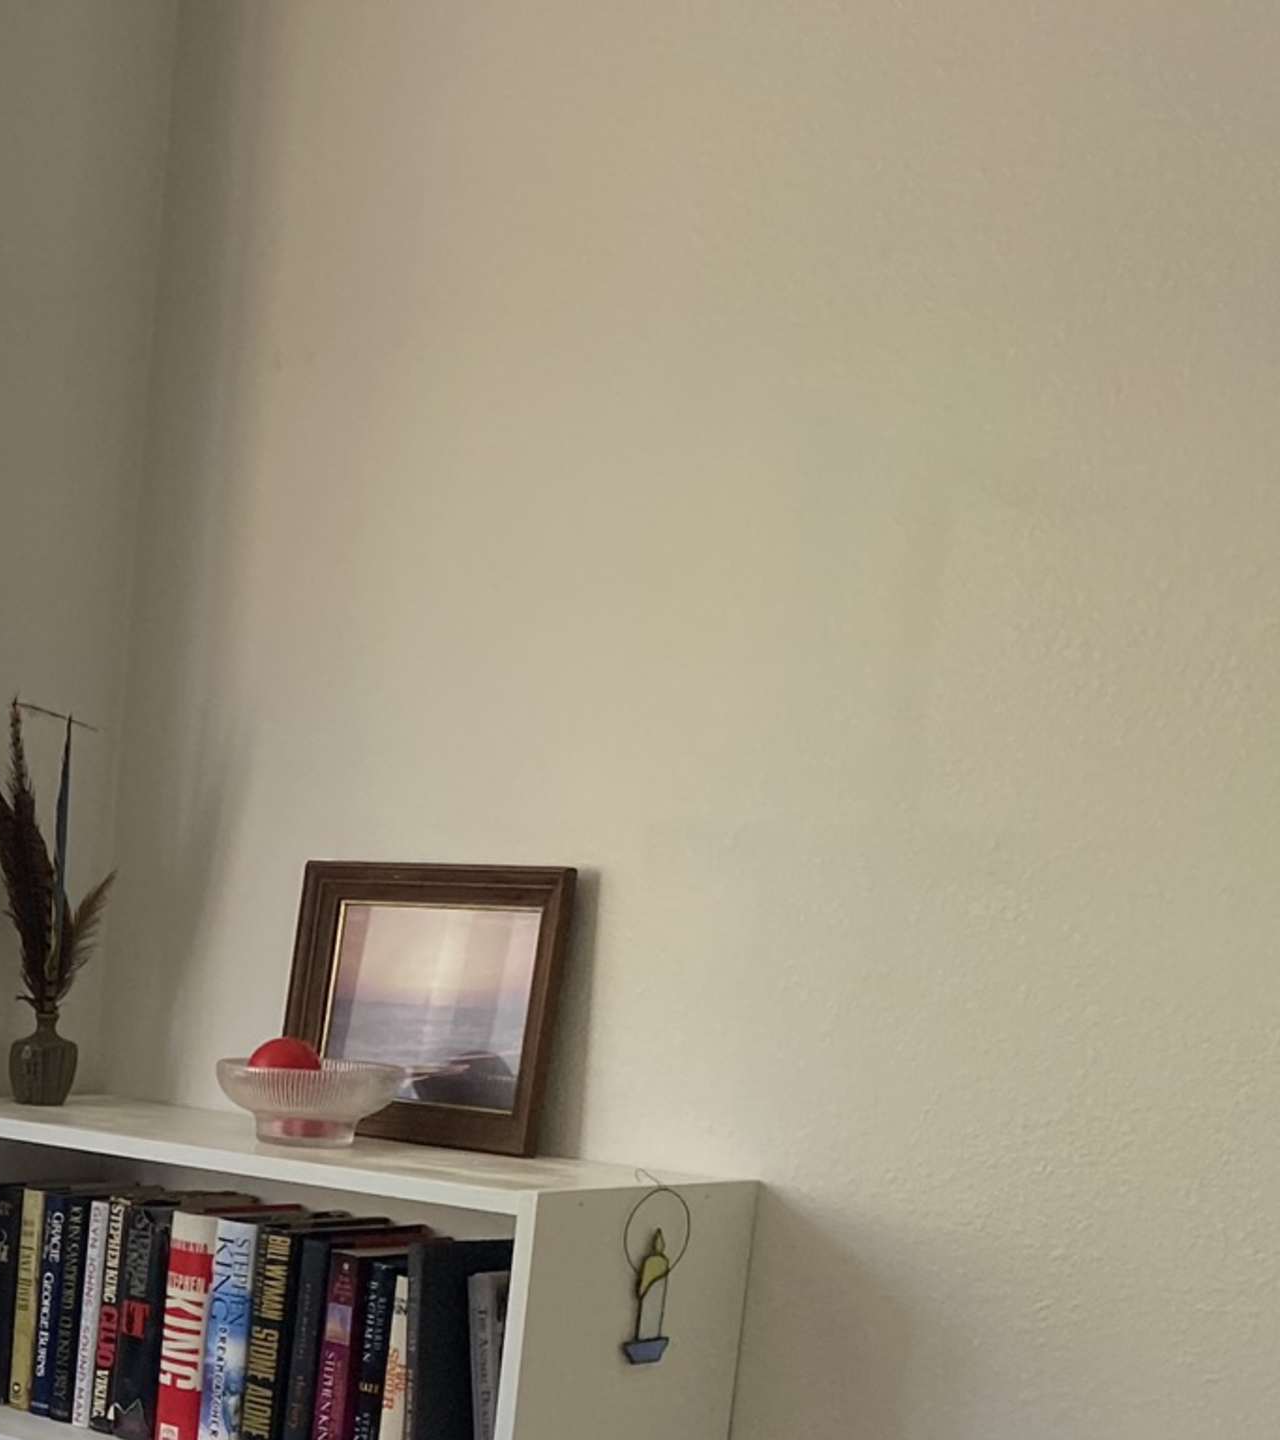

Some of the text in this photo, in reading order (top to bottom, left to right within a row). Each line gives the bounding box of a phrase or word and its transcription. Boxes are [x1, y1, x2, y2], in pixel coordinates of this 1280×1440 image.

[49, 1211, 64, 1263] GRACIE
[59, 1206, 83, 1309] JOHN SANDFORD
[82, 1205, 101, 1307] GLYN JOHNS
[103, 1203, 125, 1304] STEPHEN KING
[126, 1231, 141, 1281] KING
[130, 1207, 153, 1298] STEPHEN
[266, 1234, 292, 1261] BILL
[40, 1271, 55, 1329] GEORGE
[210, 1236, 235, 1323] KING
[227, 1237, 251, 1328] STEPHEN
[261, 1263, 289, 1321] WYMAN
[159, 1294, 204, 1391] KING
[361, 1279, 378, 1363] BACHMAN
[372, 1296, 387, 1352] RICHARD
[36, 1330, 50, 1377] BURNS
[52, 1366, 68, 1400] PREY
[74, 1323, 91, 1424] SOUND MAN
[209, 1326, 231, 1439] DREAMCATCHER
[247, 1327, 280, 1383] STONE
[321, 1351, 337, 1411] STEPHEN
[93, 1369, 110, 1418] VIKING
[242, 1389, 274, 1440] ALONE
